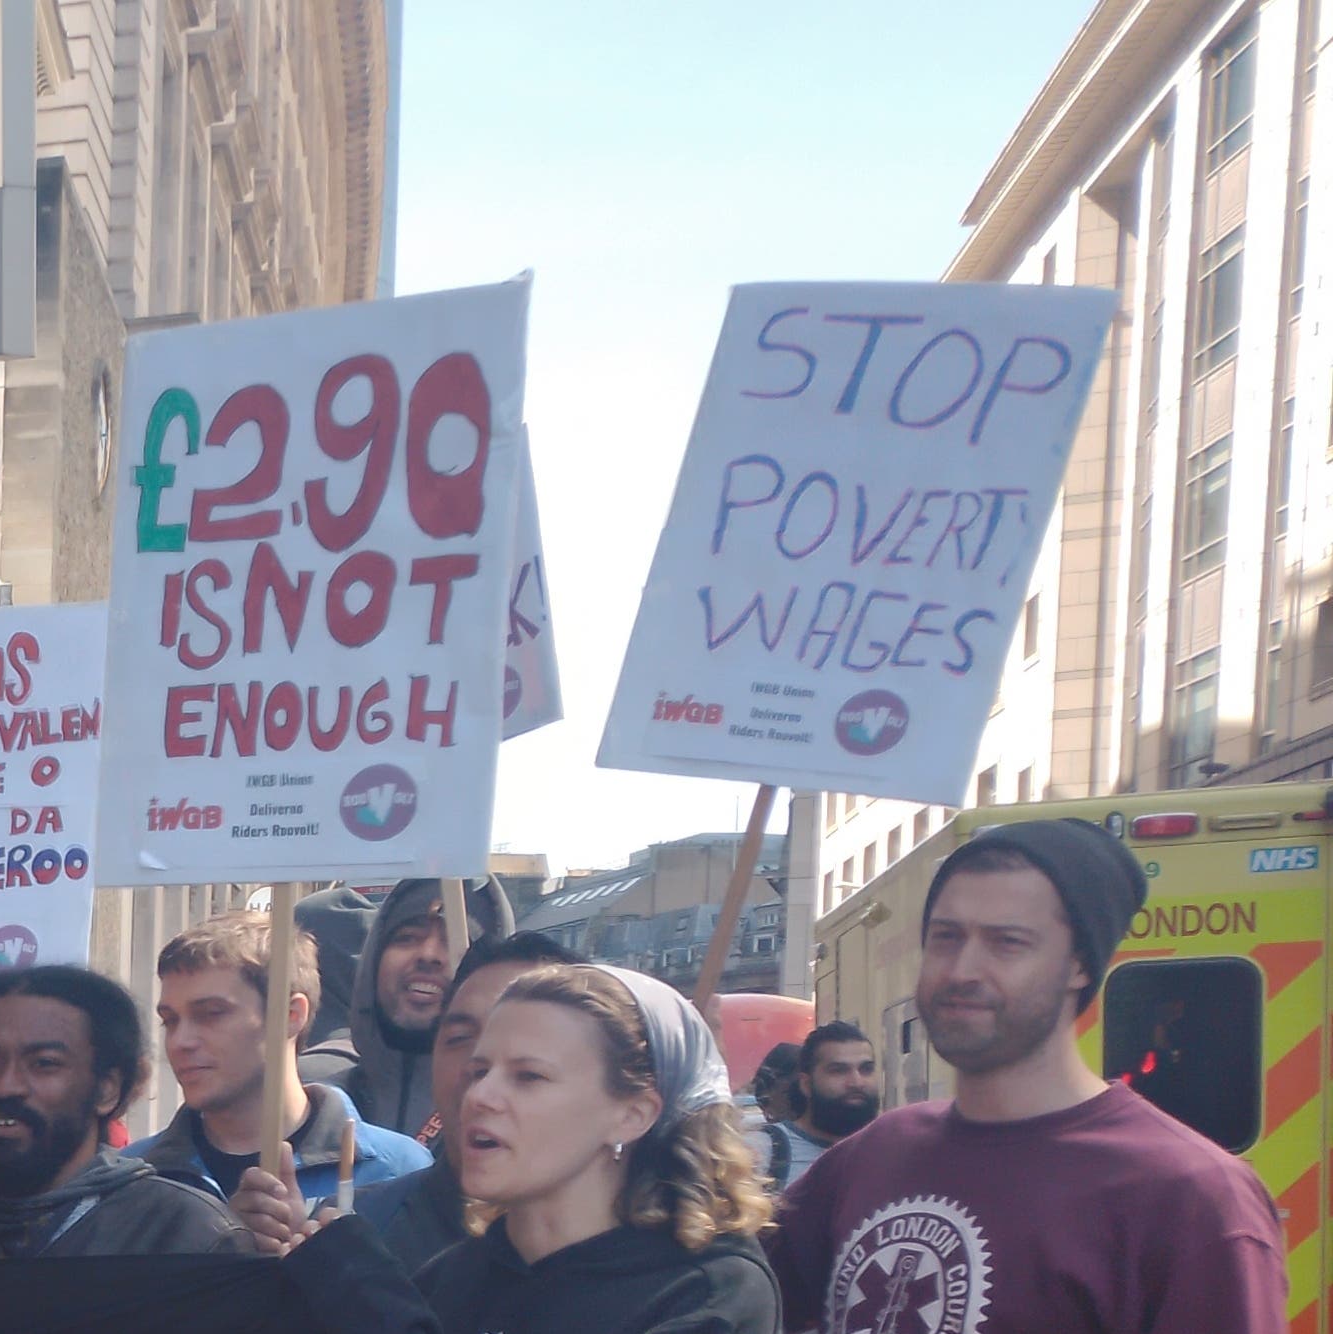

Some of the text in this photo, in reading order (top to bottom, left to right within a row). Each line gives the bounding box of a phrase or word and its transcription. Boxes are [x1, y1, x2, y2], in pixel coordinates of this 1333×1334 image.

[739, 305, 1073, 448] STOP
[131, 352, 491, 552] £2.90
[696, 580, 997, 676] WAGES
[164, 673, 459, 758] ENOUGH
[30, 755, 61, 788] O
[9, 805, 64, 836] DA
[1252, 847, 1317, 872] NHS
[1122, 902, 1256, 940] ONDON
[876, 1216, 962, 1259] LONDON
